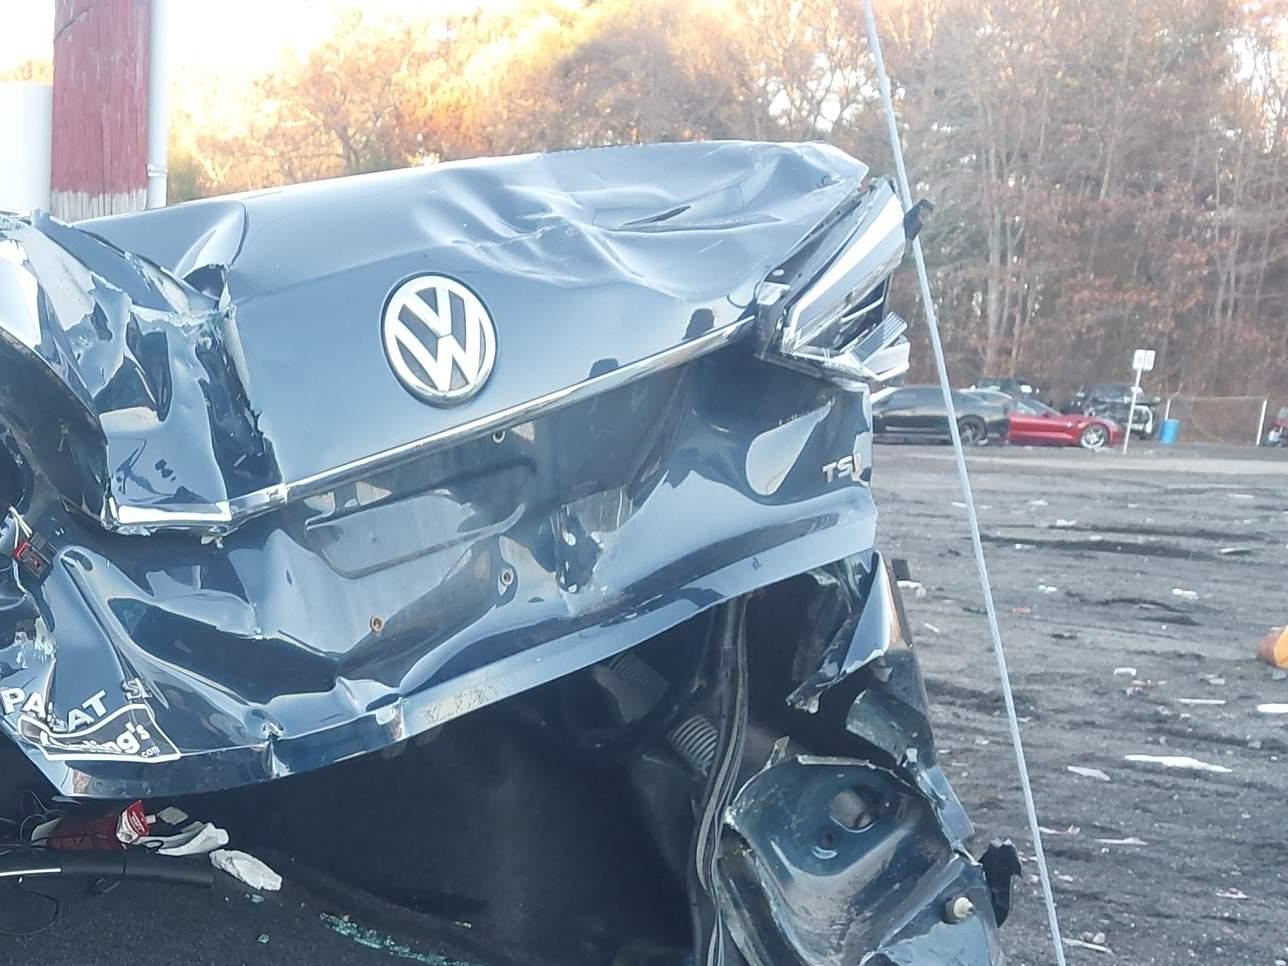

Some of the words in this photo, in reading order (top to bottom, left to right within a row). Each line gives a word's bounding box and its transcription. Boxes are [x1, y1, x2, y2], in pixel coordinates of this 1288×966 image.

[386, 279, 490, 398] VW
[821, 452, 862, 483] TSI
[0, 687, 107, 733] PAAT
